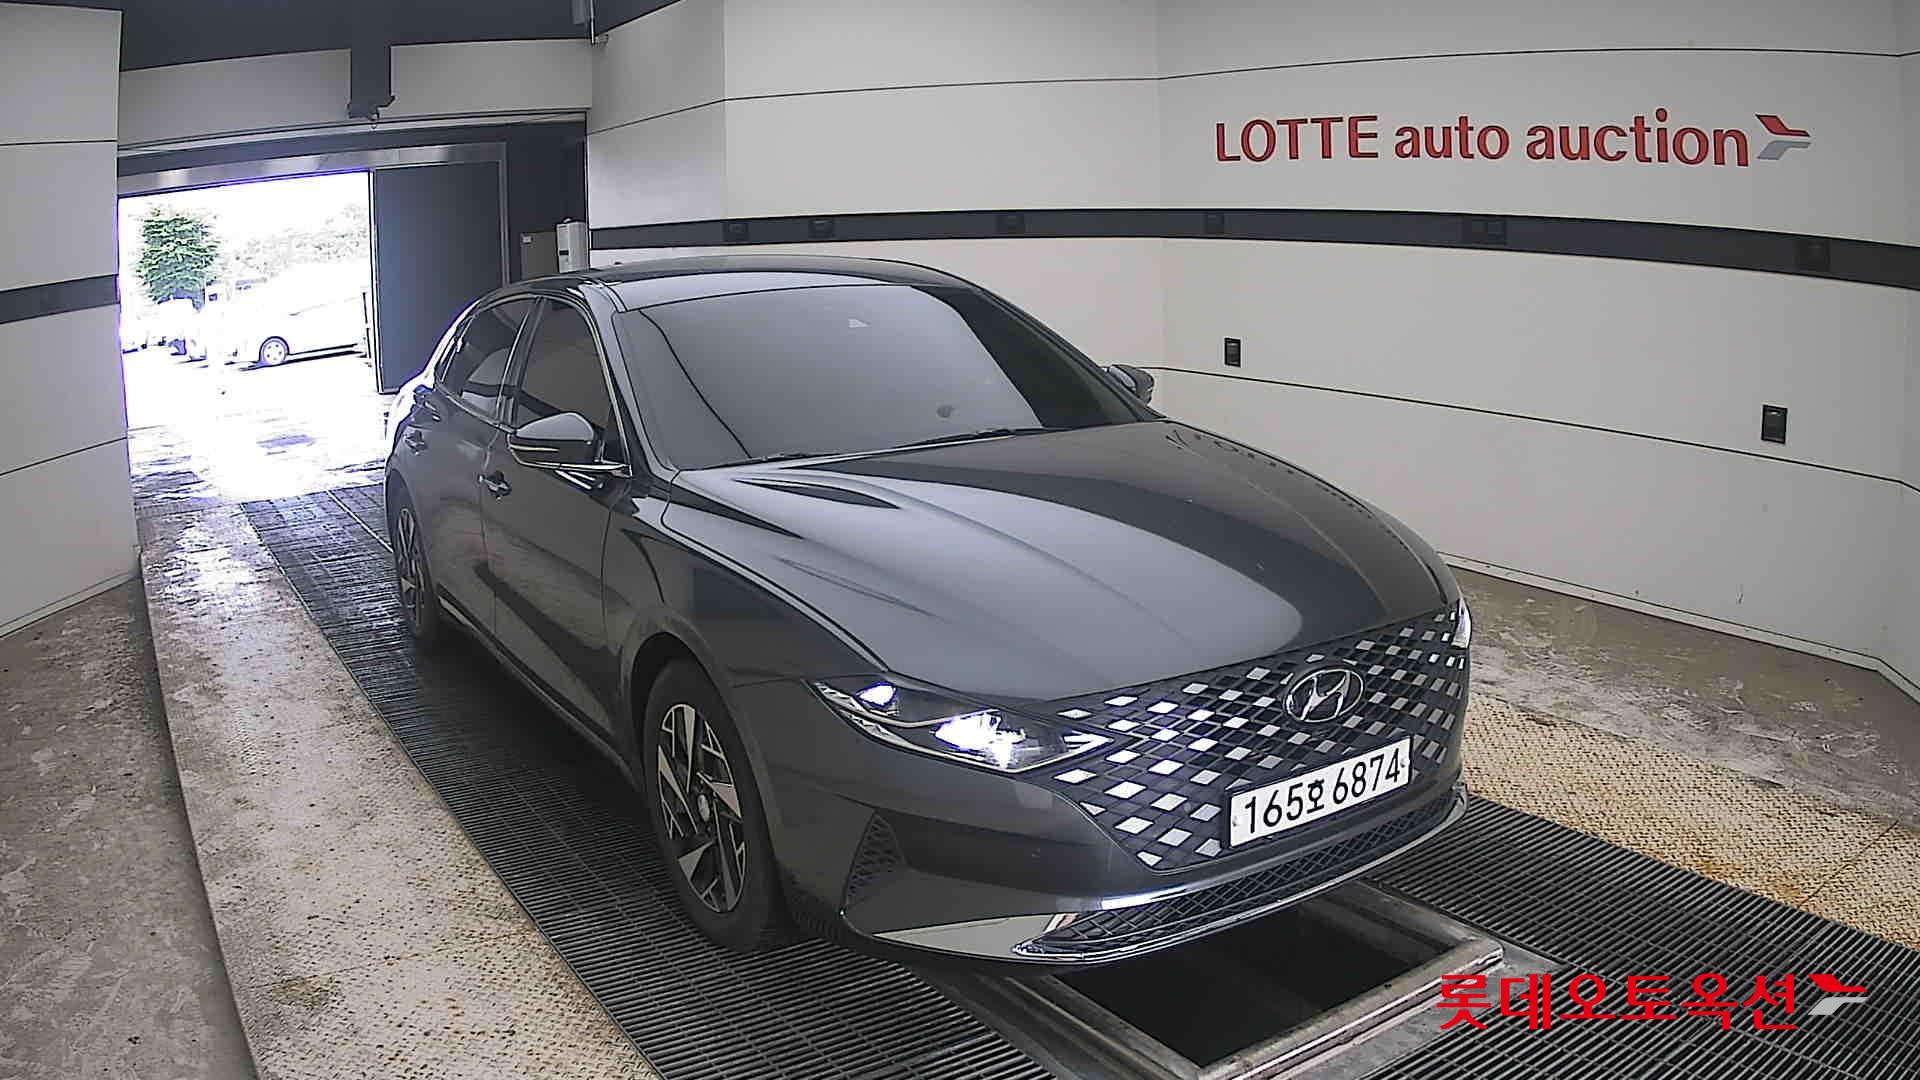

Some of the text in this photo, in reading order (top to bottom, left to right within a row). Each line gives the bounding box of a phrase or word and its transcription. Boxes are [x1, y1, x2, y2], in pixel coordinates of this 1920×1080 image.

[1215, 108, 1750, 167] LOTTE auto auction
[1332, 747, 1401, 805] 6874
